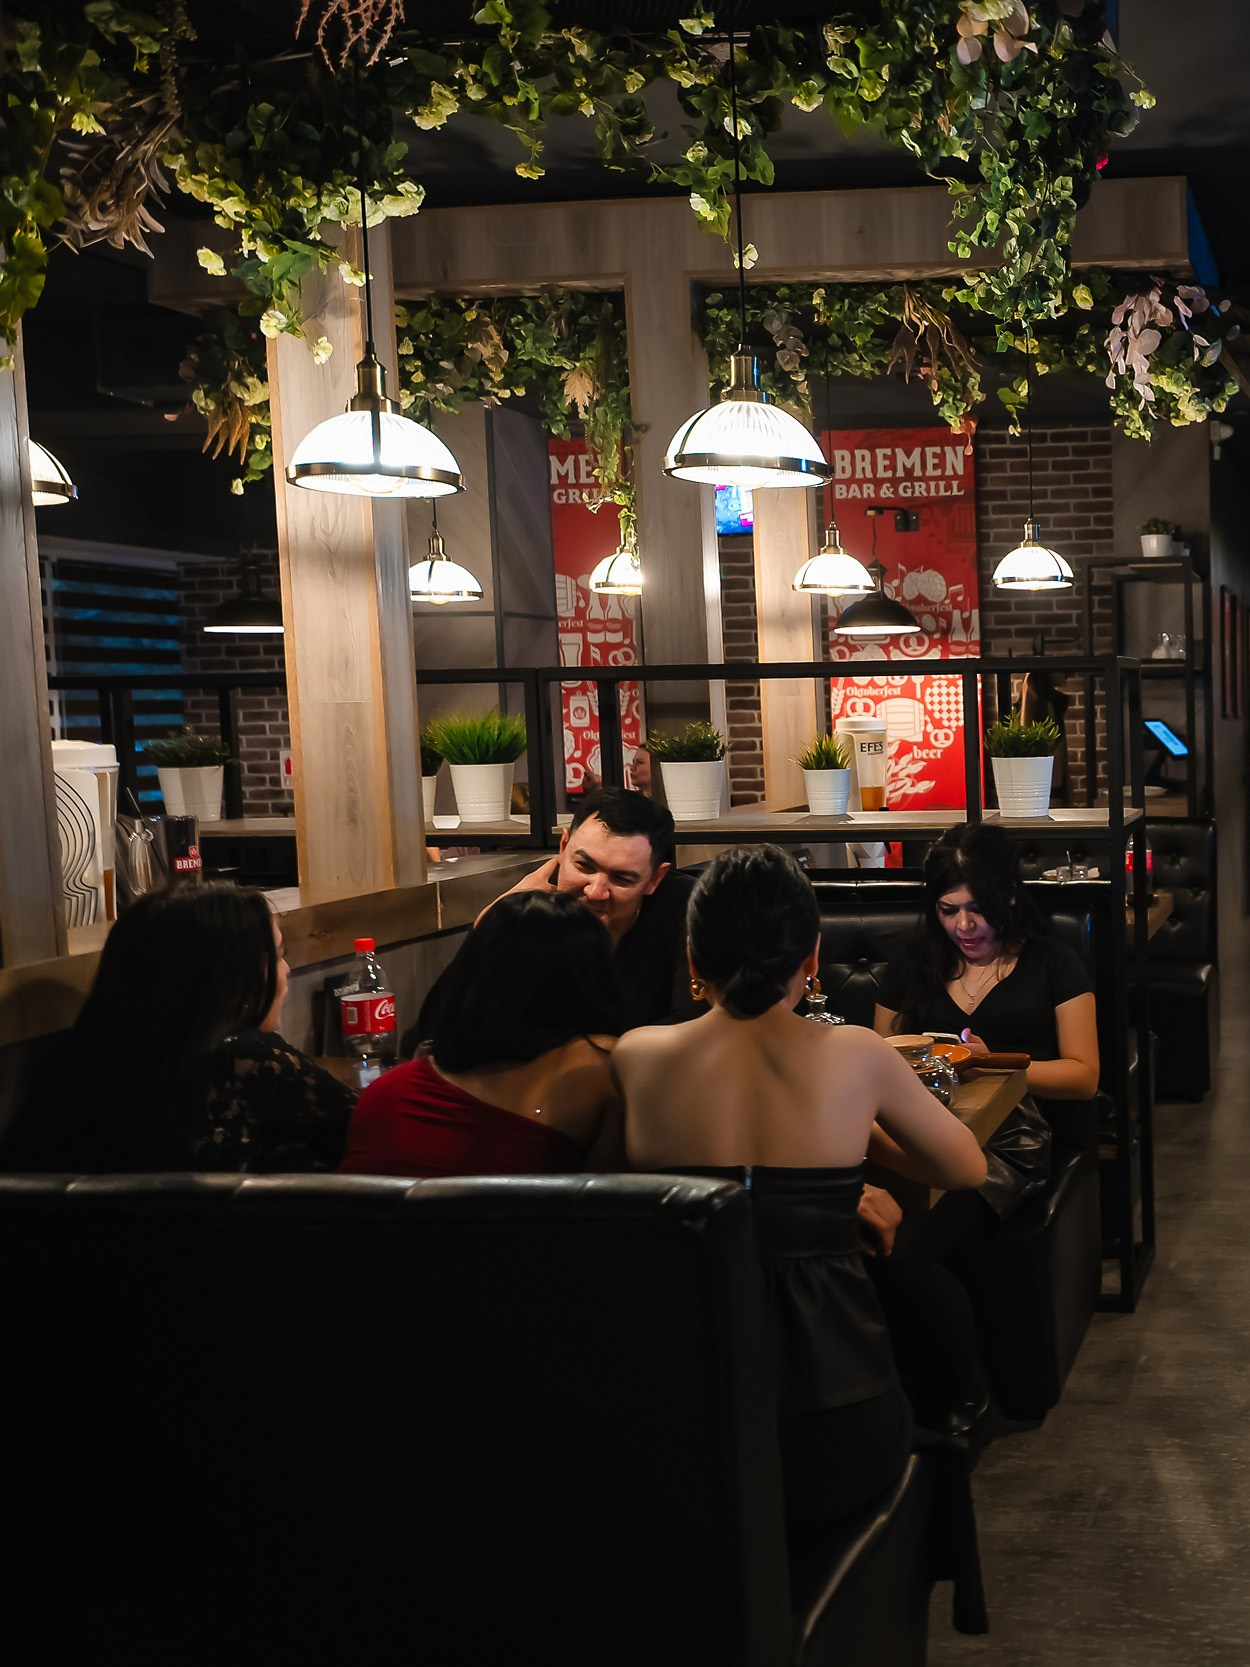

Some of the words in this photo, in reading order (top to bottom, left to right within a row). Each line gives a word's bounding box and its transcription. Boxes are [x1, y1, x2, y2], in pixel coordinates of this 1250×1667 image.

[834, 446, 964, 479] BREMEN
[835, 483, 875, 499] BAR
[880, 483, 895, 498] &
[899, 480, 965, 498] GRILL
[846, 685, 901, 697] Oktoberfest
[860, 741, 883, 752] EFES
[912, 746, 943, 759] beer
